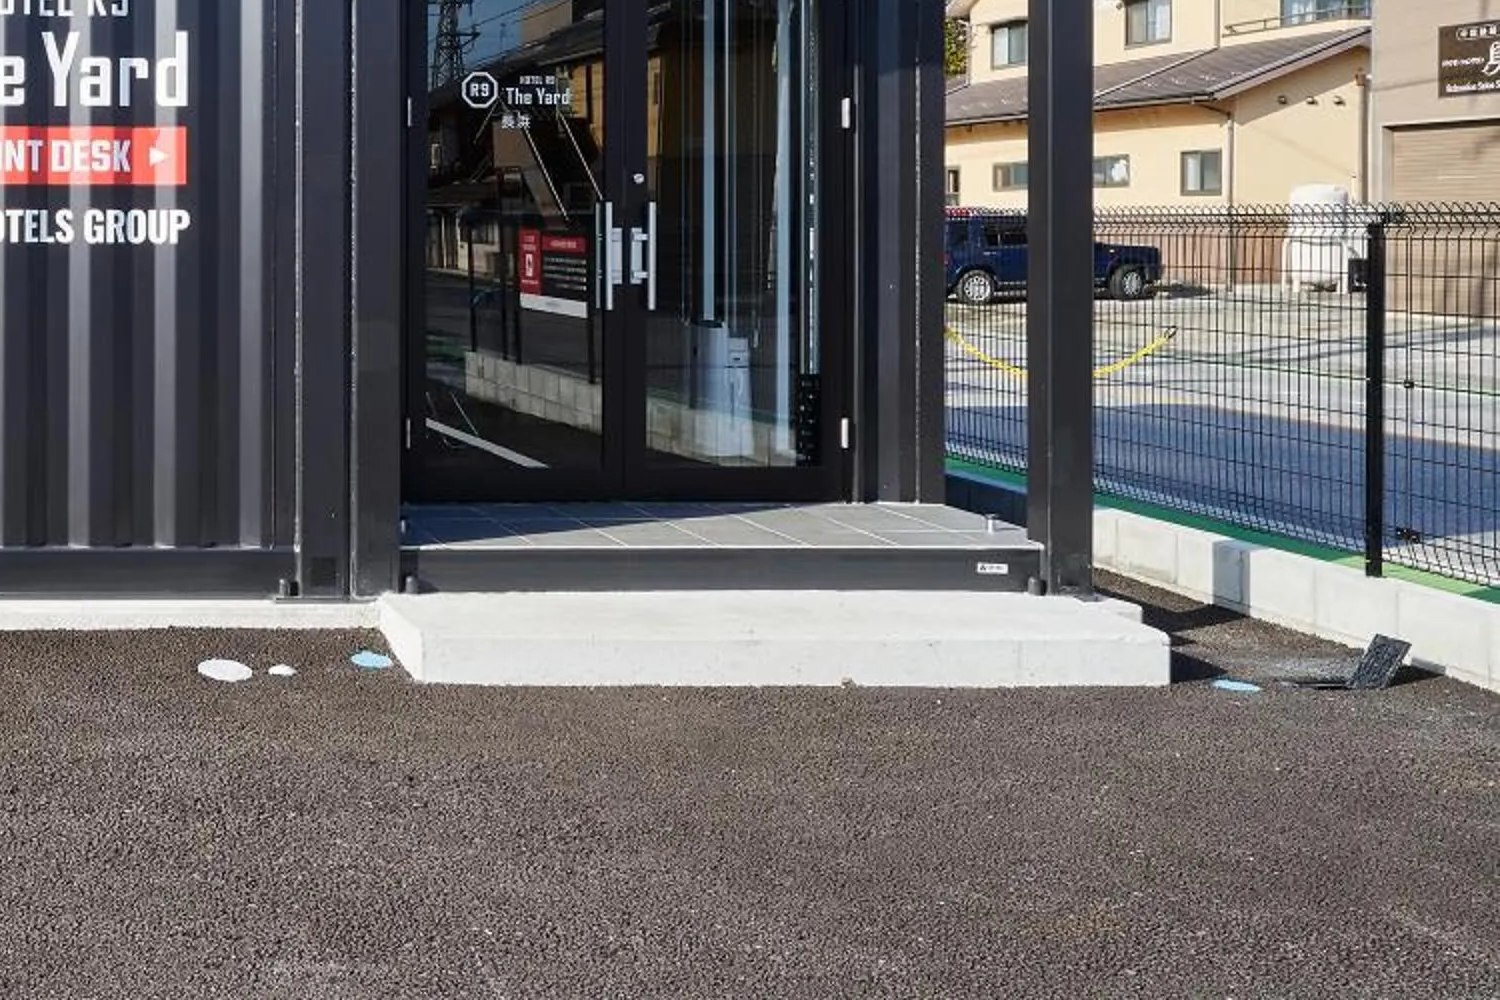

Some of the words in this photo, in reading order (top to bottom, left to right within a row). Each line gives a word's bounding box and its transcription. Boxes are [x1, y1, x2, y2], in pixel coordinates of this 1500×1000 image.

[41, 30, 189, 106] Yard
[469, 83, 490, 97] R9
[505, 87, 533, 105] The
[536, 87, 571, 105] Yard
[51, 139, 131, 172] DESK
[83, 208, 190, 244] GROUP
